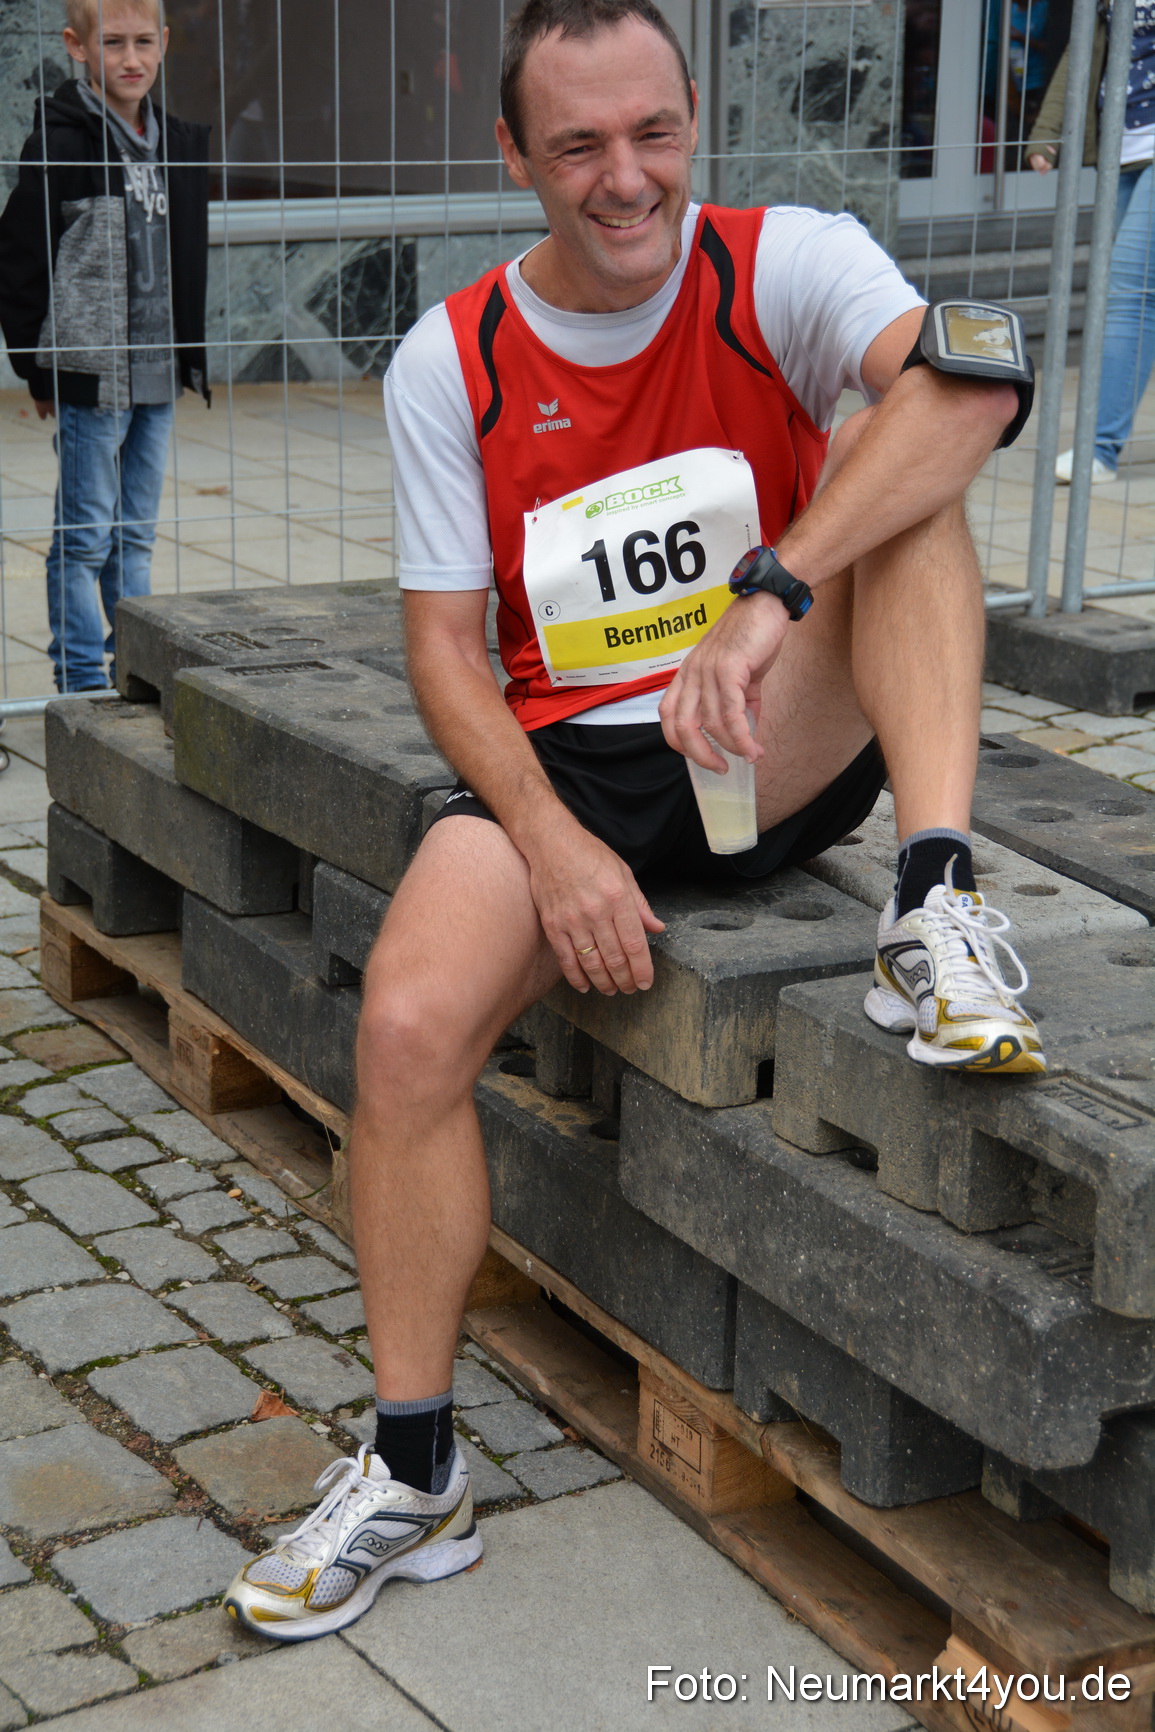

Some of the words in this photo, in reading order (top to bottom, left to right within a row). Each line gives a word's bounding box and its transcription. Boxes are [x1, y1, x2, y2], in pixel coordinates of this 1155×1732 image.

[533, 418, 572, 434] erima
[605, 475, 683, 510] BOCK
[606, 506, 630, 515] inspired
[640, 499, 657, 507] smart
[659, 493, 685, 502] concepts
[581, 520, 707, 602] 166
[545, 605, 554, 616] C
[604, 603, 708, 649] Bernhard
